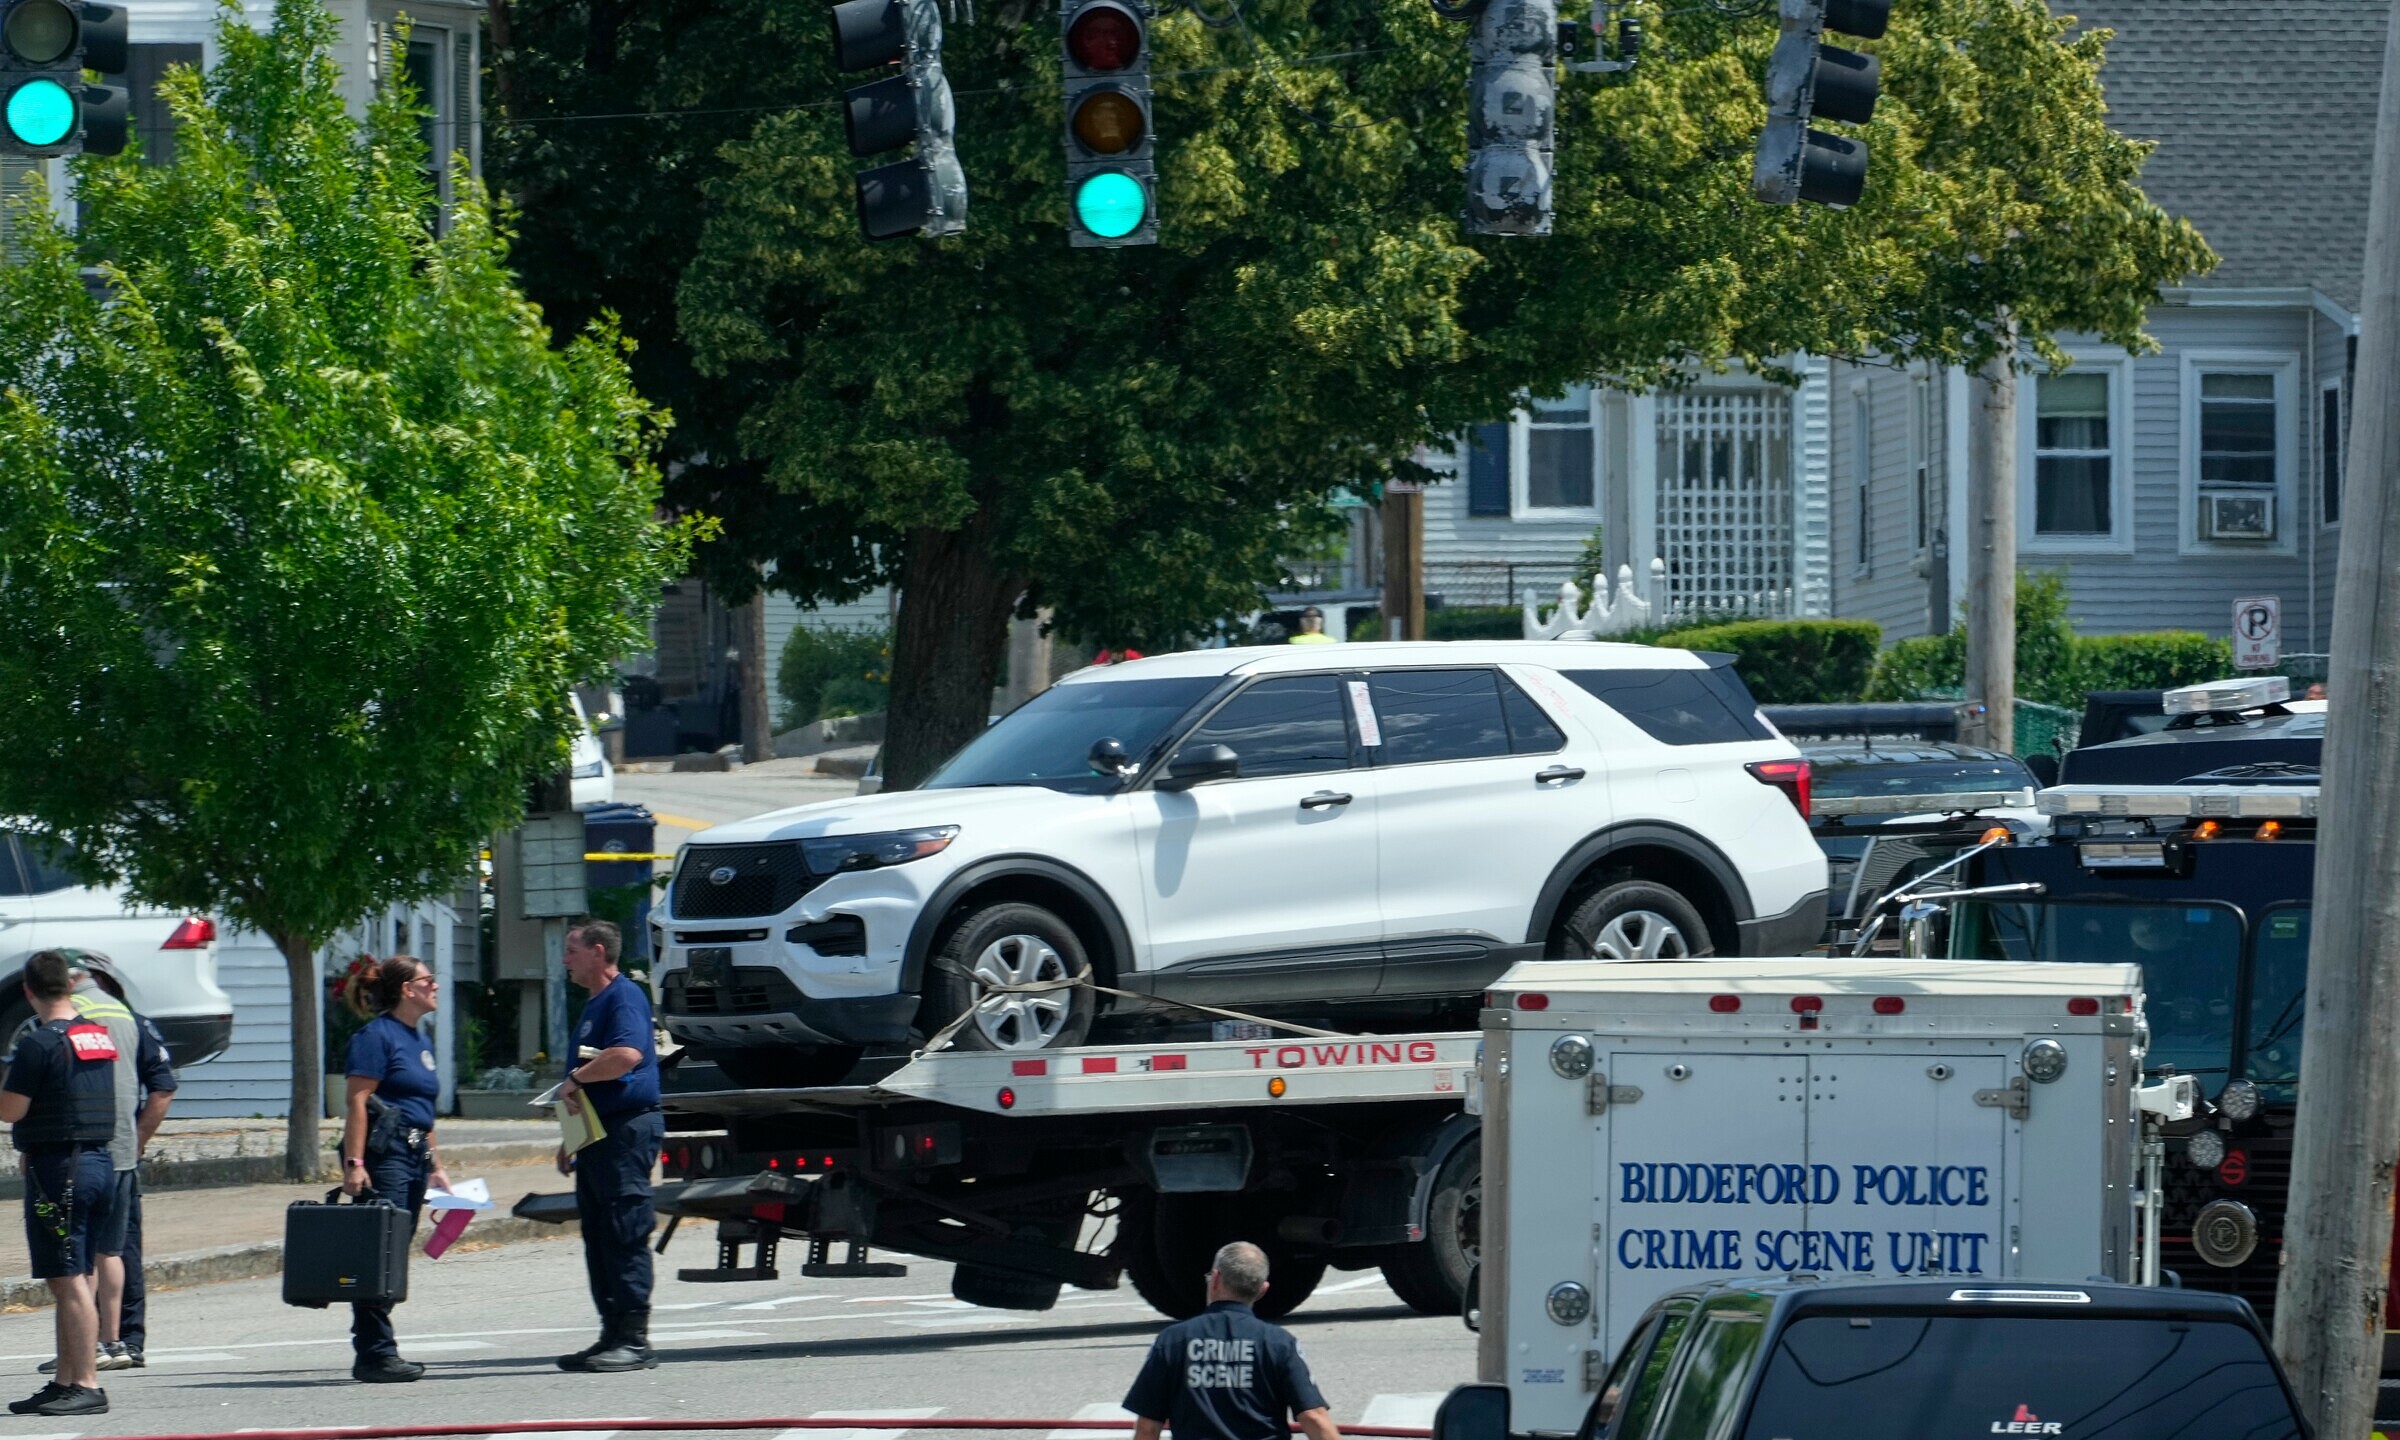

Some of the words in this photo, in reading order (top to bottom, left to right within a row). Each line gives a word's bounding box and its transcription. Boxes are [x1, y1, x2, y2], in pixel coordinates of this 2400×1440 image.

[1245, 1042, 1436, 1069] TOWING
[1619, 1162, 1840, 1204] BIDDEFORD
[1852, 1164, 1989, 1206] POLICE
[1617, 1229, 1742, 1270] CRIME
[1755, 1230, 1875, 1272] SCENE
[1887, 1231, 1989, 1273] UNIT
[1187, 1338, 1256, 1362] CRIME
[1187, 1364, 1253, 1389] SCENE
[1990, 1421, 2062, 1435] LEER
